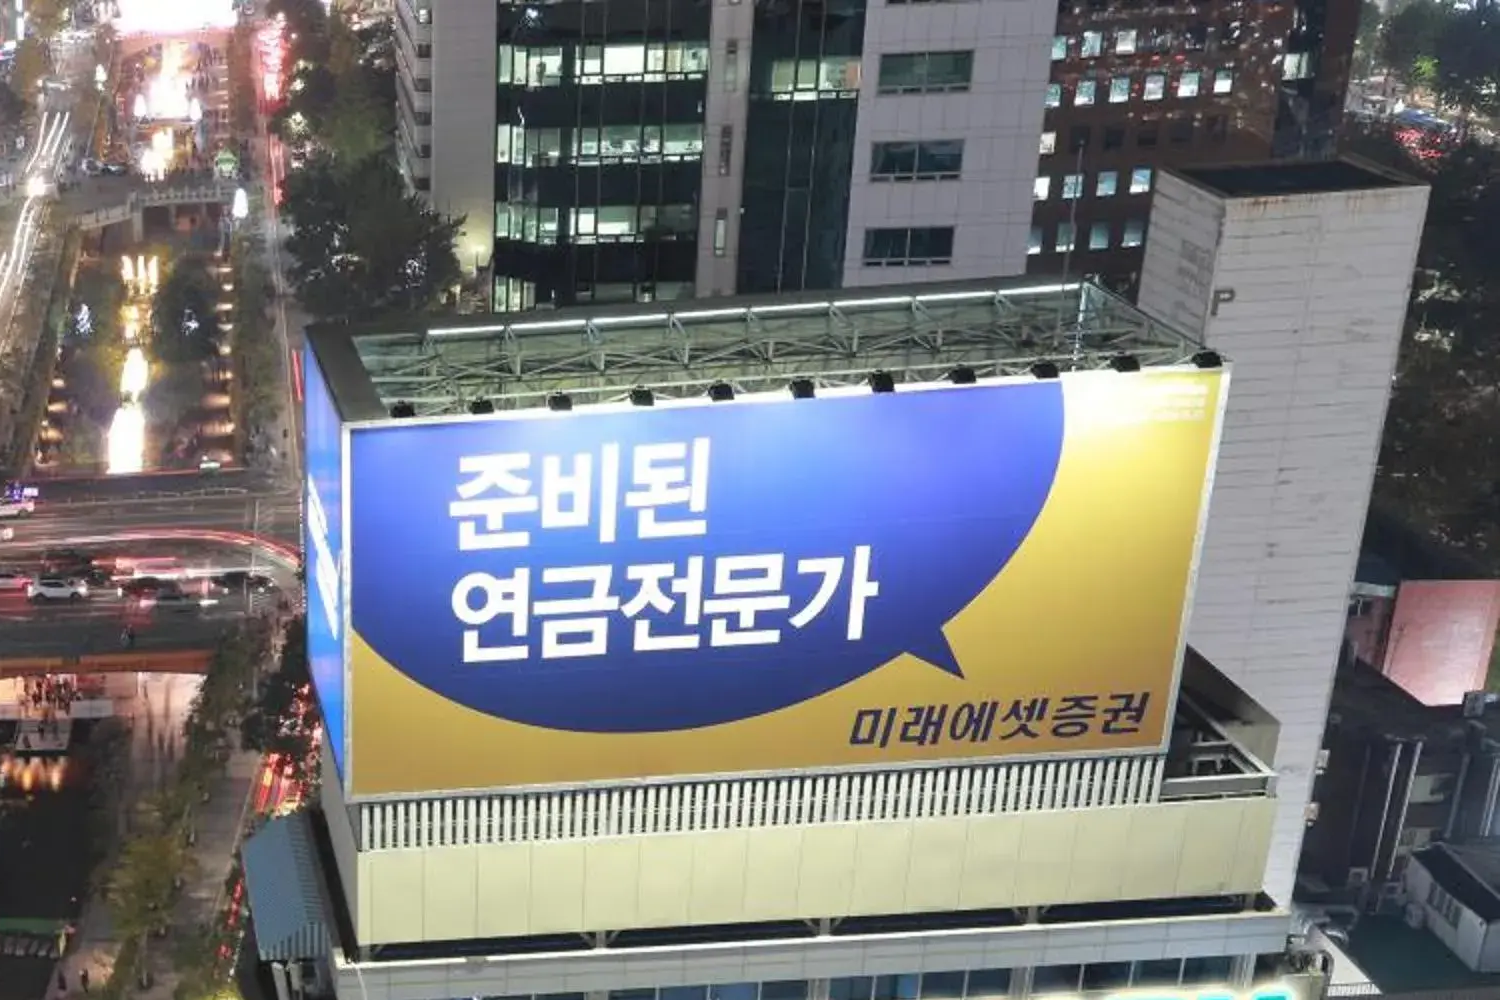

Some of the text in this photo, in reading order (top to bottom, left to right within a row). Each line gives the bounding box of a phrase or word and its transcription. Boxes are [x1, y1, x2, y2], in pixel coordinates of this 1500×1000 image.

[1210, 288, 1236, 317] P
[449, 437, 713, 552] 준비된
[451, 545, 881, 665] 연금전문가
[849, 691, 1152, 749] 미래에셋증권
